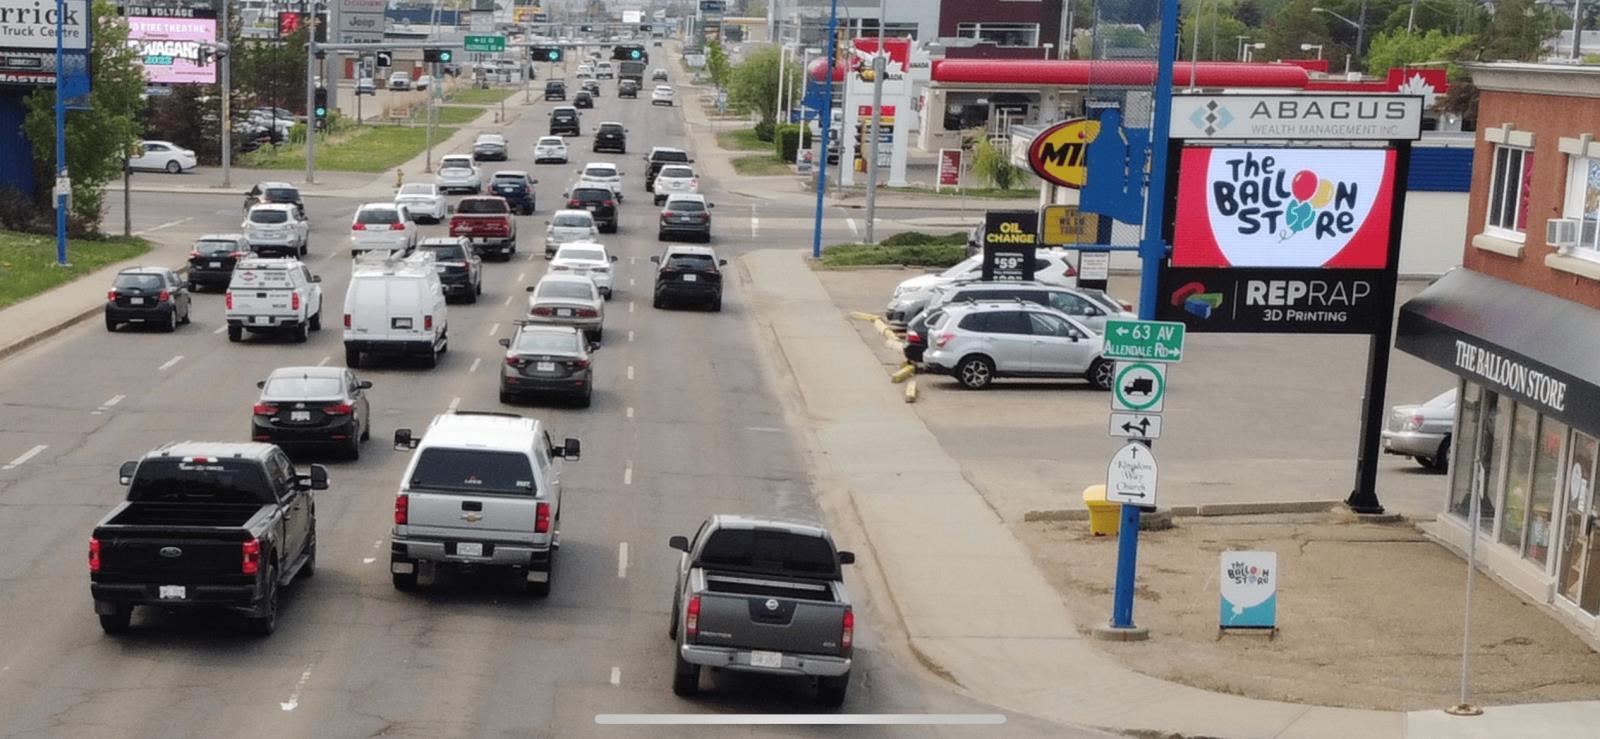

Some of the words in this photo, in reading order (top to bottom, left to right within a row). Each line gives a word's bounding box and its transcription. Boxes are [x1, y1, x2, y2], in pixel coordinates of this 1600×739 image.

[349, 16, 375, 28] Jeep
[3, 26, 34, 37] Truck
[1250, 100, 1407, 120] ABACUS
[1251, 124, 1296, 135] WEALTH
[1299, 125, 1377, 136] MANAGEMENT
[1225, 151, 1275, 183] The
[1000, 222, 1023, 233] OIL
[986, 233, 1035, 243] CHANGE
[1246, 280, 1370, 306] REPRAP
[1263, 308, 1283, 321] 3D
[1132, 325, 1151, 340] 63
[1156, 326, 1174, 341] AV
[1104, 339, 1153, 357] ALLENDALE
[1456, 340, 1477, 372] THE
[1476, 348, 1528, 394] BALLOON
[1526, 369, 1567, 411] STORE
[1116, 481, 1146, 491] Church
